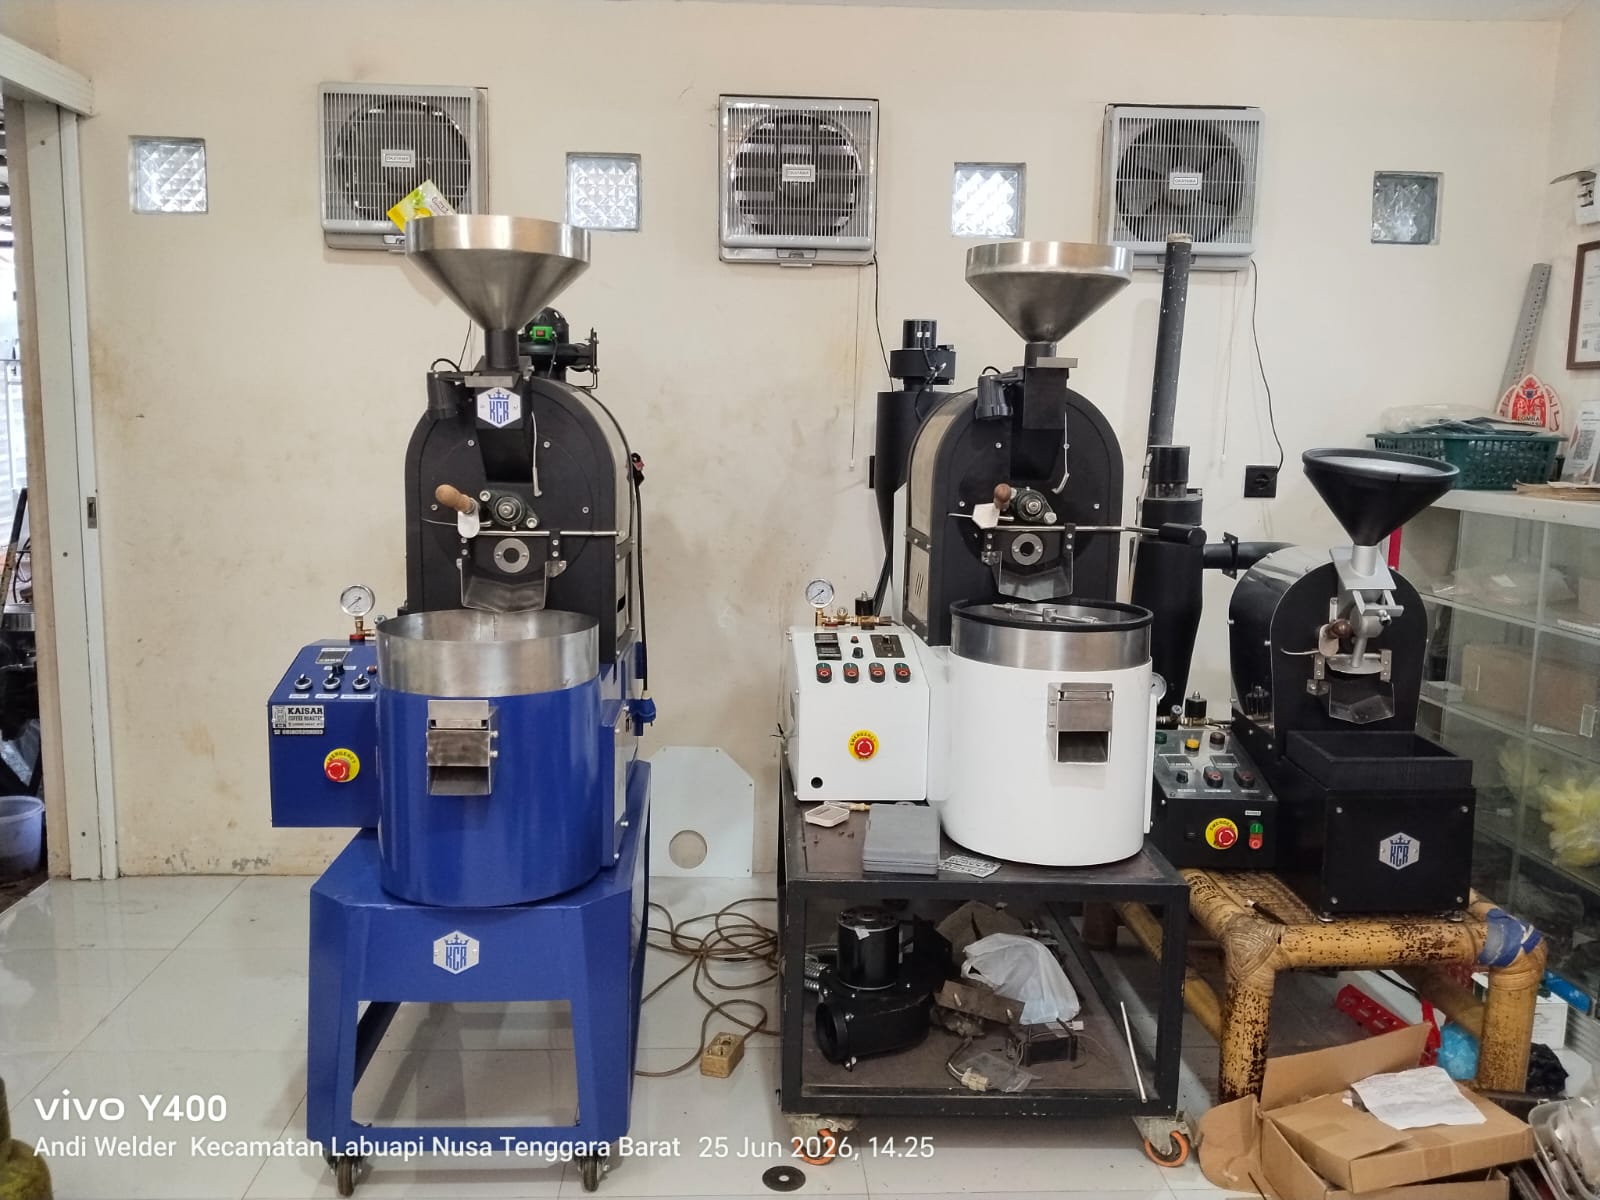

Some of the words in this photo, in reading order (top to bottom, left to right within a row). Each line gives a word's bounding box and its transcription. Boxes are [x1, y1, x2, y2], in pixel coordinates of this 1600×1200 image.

[489, 400, 509, 424] KCR
[287, 707, 323, 715] KAISAR
[1390, 845, 1409, 867] KCR
[445, 946, 467, 971] KCR
